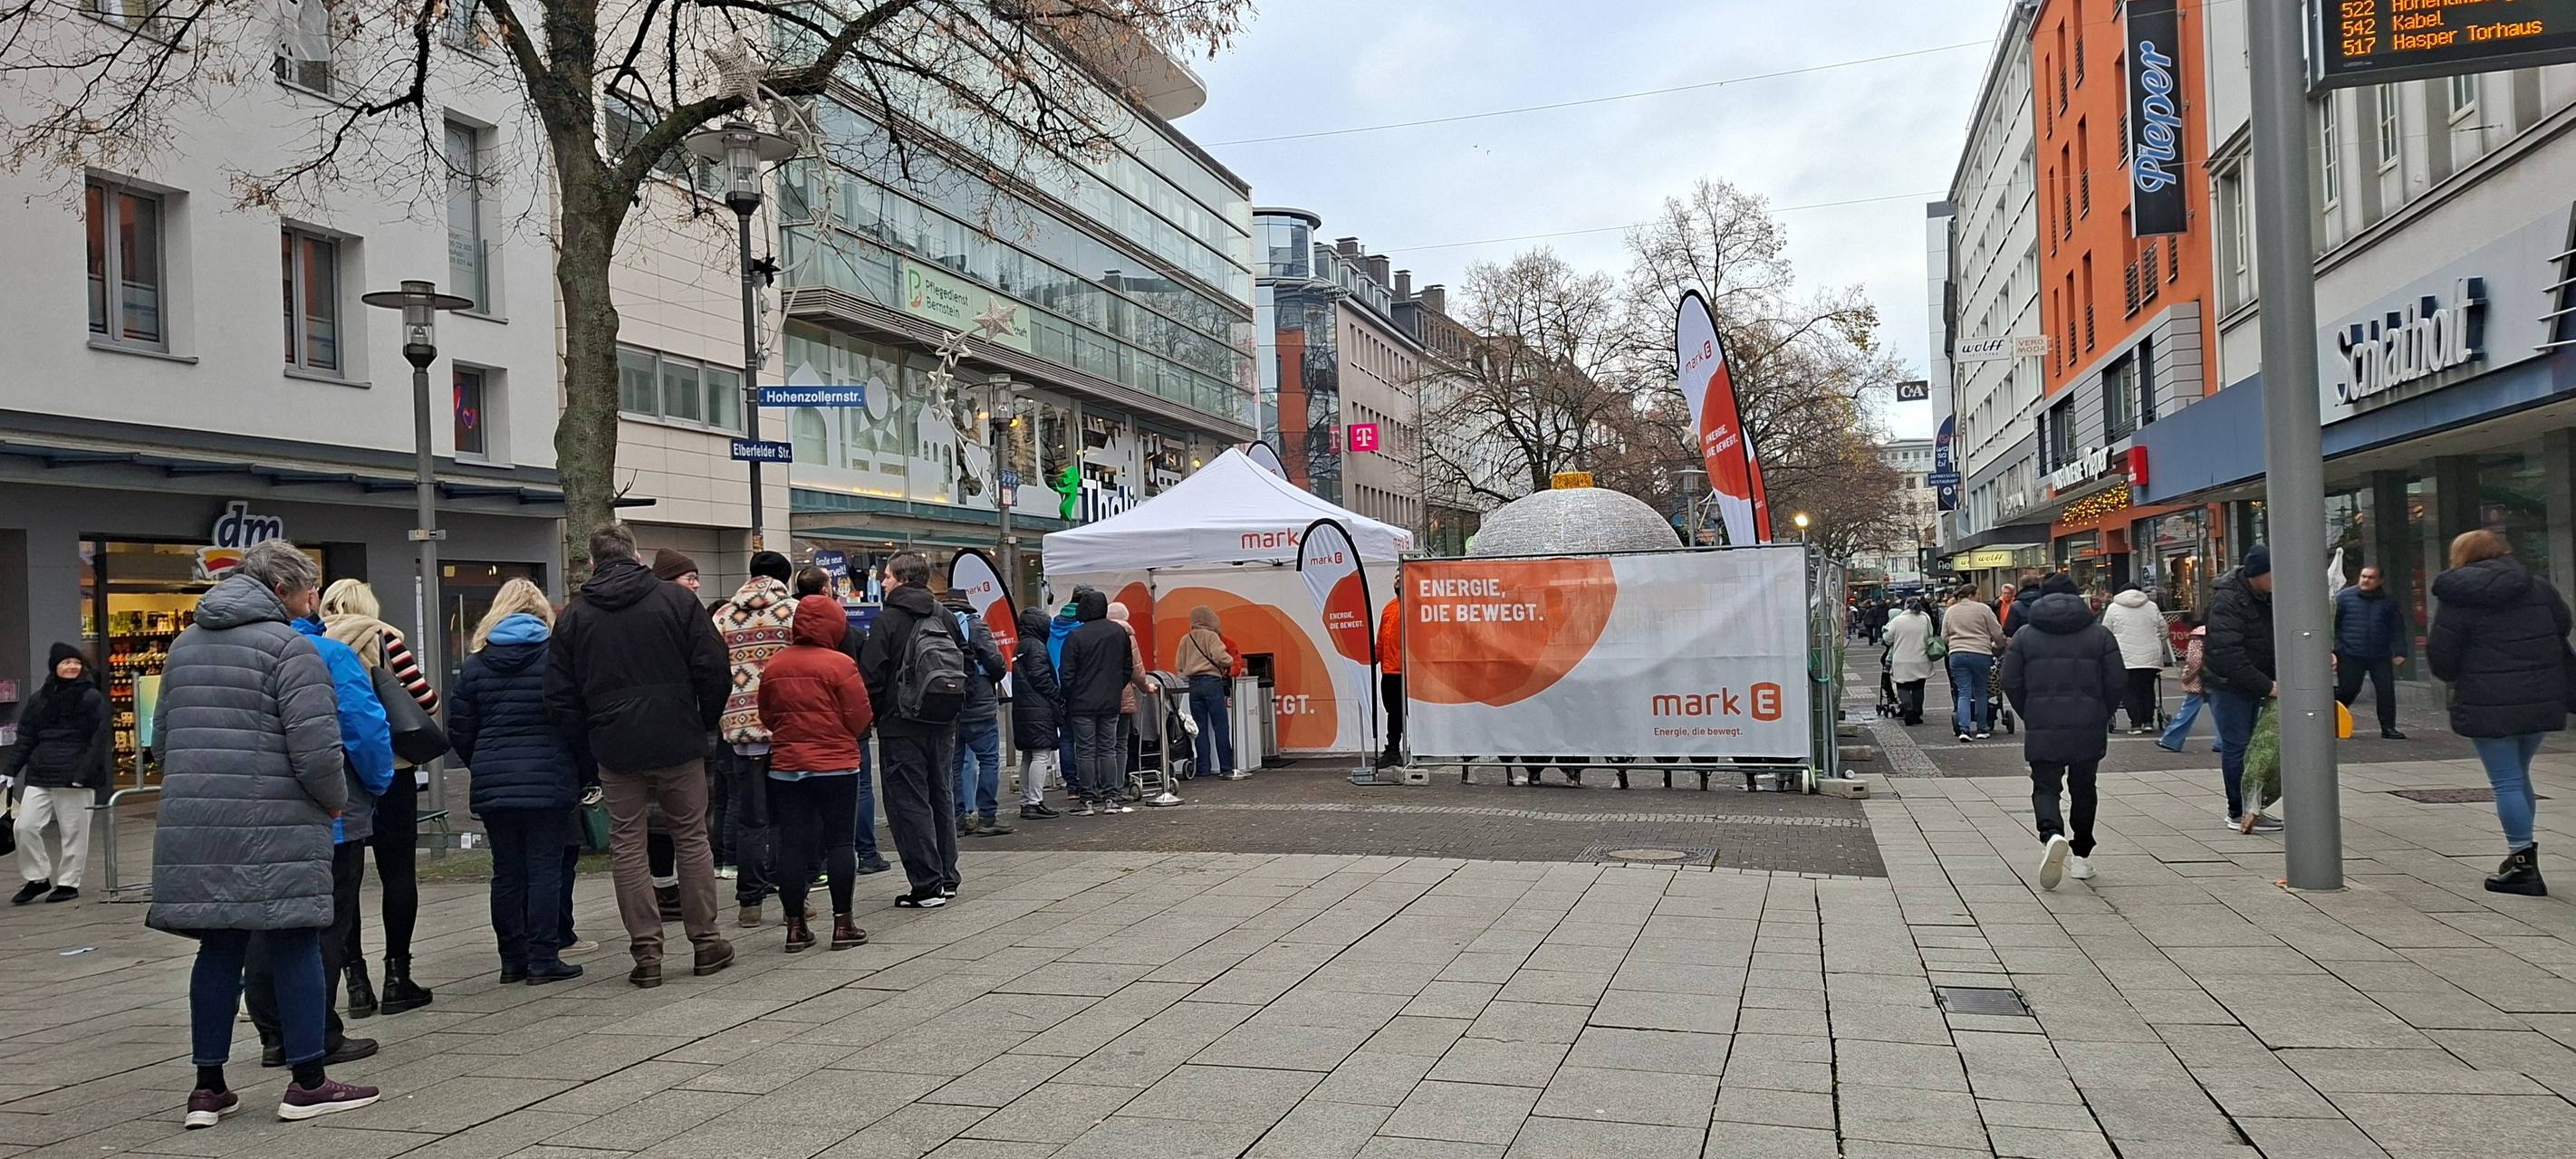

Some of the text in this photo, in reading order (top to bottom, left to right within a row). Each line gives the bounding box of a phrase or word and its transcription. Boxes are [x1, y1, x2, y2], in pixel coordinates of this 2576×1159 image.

[2341, 0, 2375, 18] 522
[2342, 11, 2444, 36] 542 Kabel
[2342, 19, 2543, 55] 517 Hasper Torhaus
[2134, 41, 2181, 192] Pieper
[925, 280, 968, 307] Pflegedienst
[927, 297, 960, 319] Bernstein
[1962, 340, 2004, 353] wolff
[1685, 350, 1704, 374] mark
[766, 391, 861, 403] Hohenzollernstr.
[1900, 386, 1924, 398] C&A
[733, 443, 792, 459] Elberfelder Str.
[2083, 446, 2109, 481] Pieper
[1082, 478, 1144, 522] Thali
[216, 504, 280, 549] dm
[1241, 528, 1299, 549] mark
[1310, 554, 1332, 565] mark
[1978, 553, 2003, 562] wolff
[1419, 579, 1506, 598] ENERGIE,
[1420, 603, 1543, 623] DIE BEWEGT.
[1340, 620, 1364, 629] BEWEGT.
[1652, 687, 1741, 716] mark
[1654, 727, 1743, 737] Energie, die bewegt.
